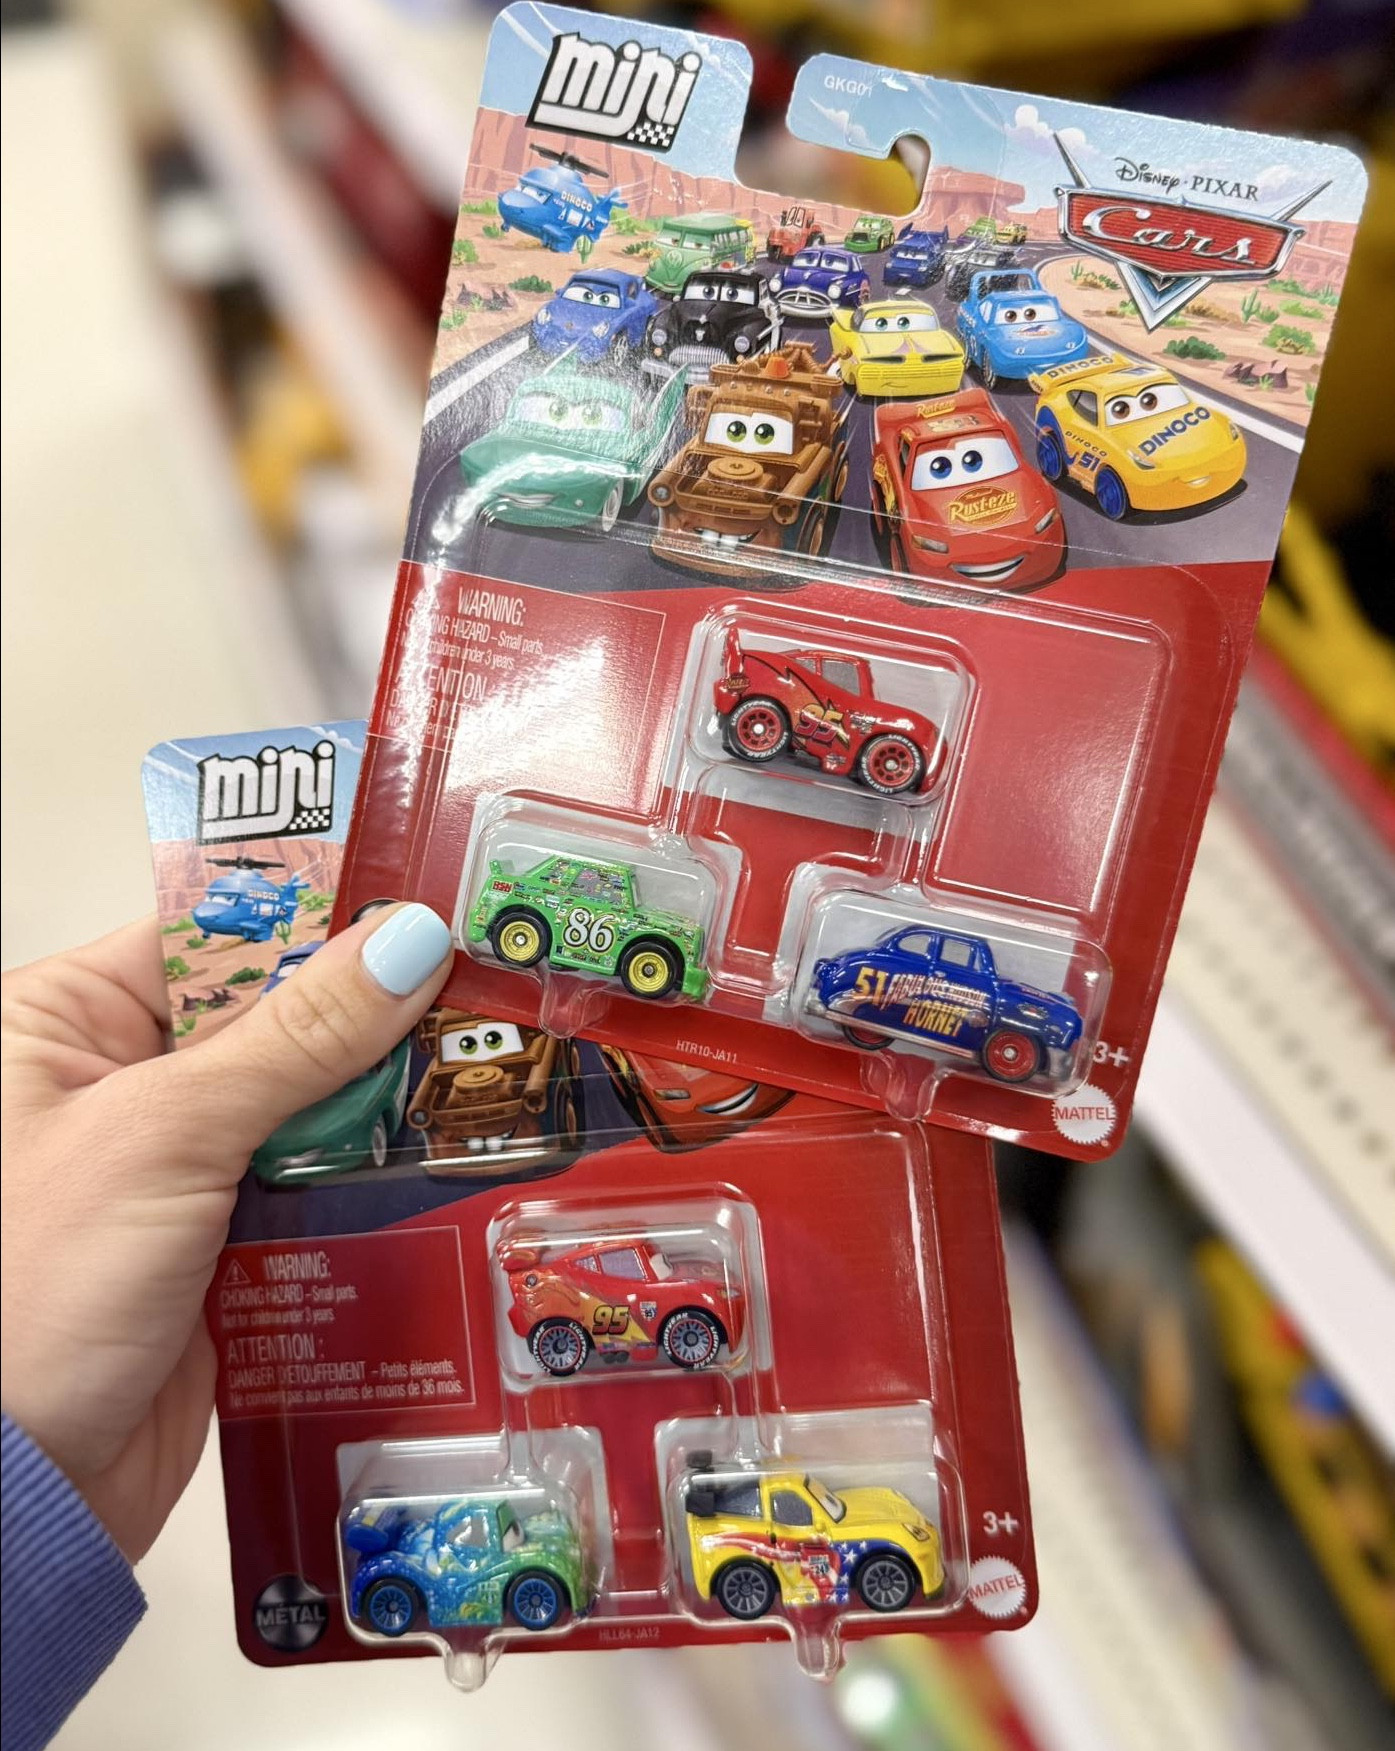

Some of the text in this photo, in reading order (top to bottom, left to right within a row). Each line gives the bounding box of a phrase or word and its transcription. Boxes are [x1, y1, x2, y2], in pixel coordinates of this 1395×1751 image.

[532, 33, 701, 138] mini
[561, 190, 592, 212] DINOCO
[1190, 175, 1259, 202] PIXAR
[1082, 204, 1257, 265] Cars
[1047, 356, 1114, 379] DINOCO
[1065, 430, 1108, 457] DINOCO
[1138, 406, 1211, 456] DINOCO
[1078, 451, 1101, 472] 51
[458, 587, 526, 627] WARNING:
[450, 617, 491, 643] HAZARD
[485, 649, 492, 665] 3
[795, 703, 845, 747] 95
[201, 740, 335, 840] mini
[563, 906, 615, 954] 86
[852, 966, 887, 1005] 51
[676, 1040, 737, 1064] HTR10-JA11
[1093, 1040, 1130, 1068] 3+
[1055, 1106, 1116, 1121] MATTEL
[263, 1251, 331, 1281] WARNING:
[592, 1305, 630, 1336] 95
[228, 1333, 316, 1364] ATTENTION
[408, 1378, 420, 1396] de
[421, 1378, 435, 1395] 36
[983, 1511, 1018, 1535] 3+
[968, 1574, 1025, 1599] MATTEL
